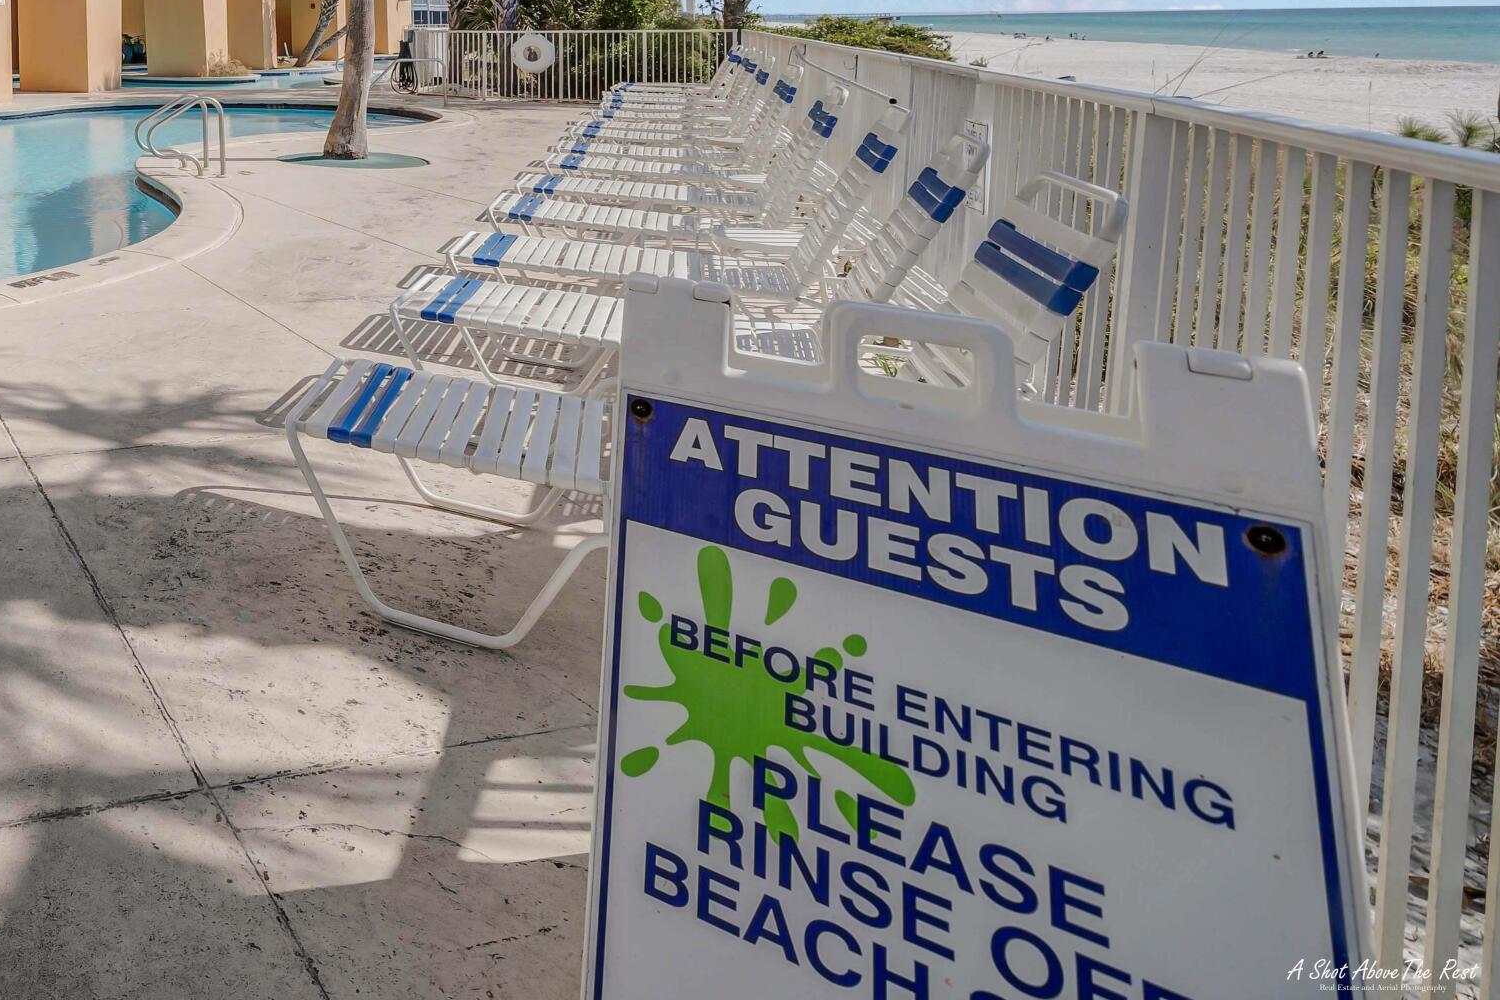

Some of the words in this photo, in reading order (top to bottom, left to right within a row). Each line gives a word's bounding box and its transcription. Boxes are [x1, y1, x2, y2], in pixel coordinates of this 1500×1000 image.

[669, 416, 1231, 589] ATTENTION
[734, 487, 1131, 635] GUESTS
[669, 614, 876, 712] BEFORE
[896, 685, 1237, 832] ENTERING
[784, 696, 1068, 824] BUILDING
[642, 840, 930, 1000] BEACH
[698, 798, 956, 962] RINSE
[990, 925, 1200, 1000] OF
[752, 755, 1112, 950] PLEASE
